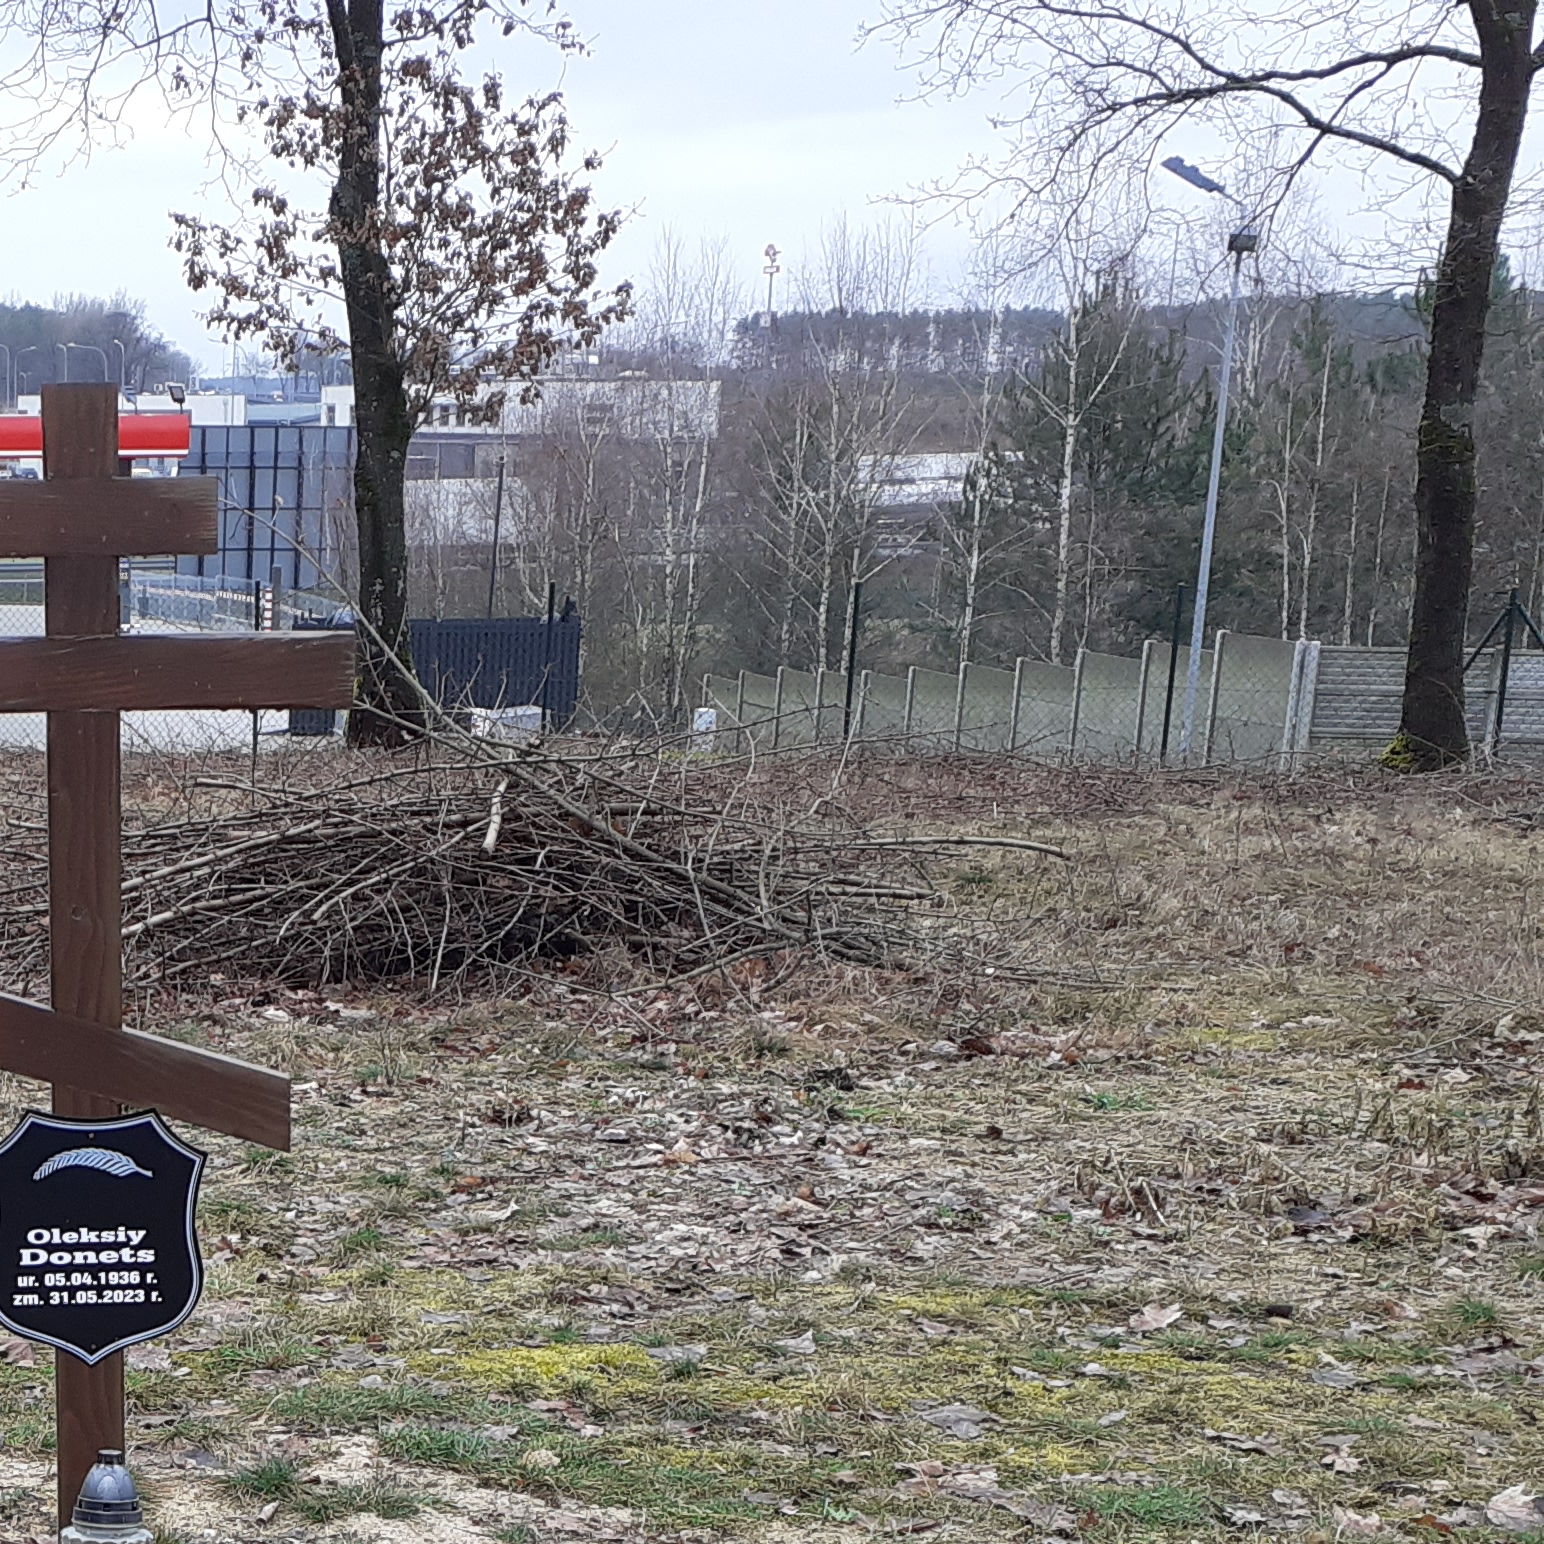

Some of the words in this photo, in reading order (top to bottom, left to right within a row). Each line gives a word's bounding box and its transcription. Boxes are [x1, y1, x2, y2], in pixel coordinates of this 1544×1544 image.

[26, 1226, 147, 1246] Oleksiy
[19, 1247, 156, 1266] Donets
[17, 1275, 39, 1287] ur.
[44, 1271, 141, 1287] 05.04.1936
[146, 1272, 158, 1284] r.
[12, 1294, 45, 1306] zm.
[49, 1289, 146, 1305] 31.05.2023
[151, 1291, 163, 1302] r.
